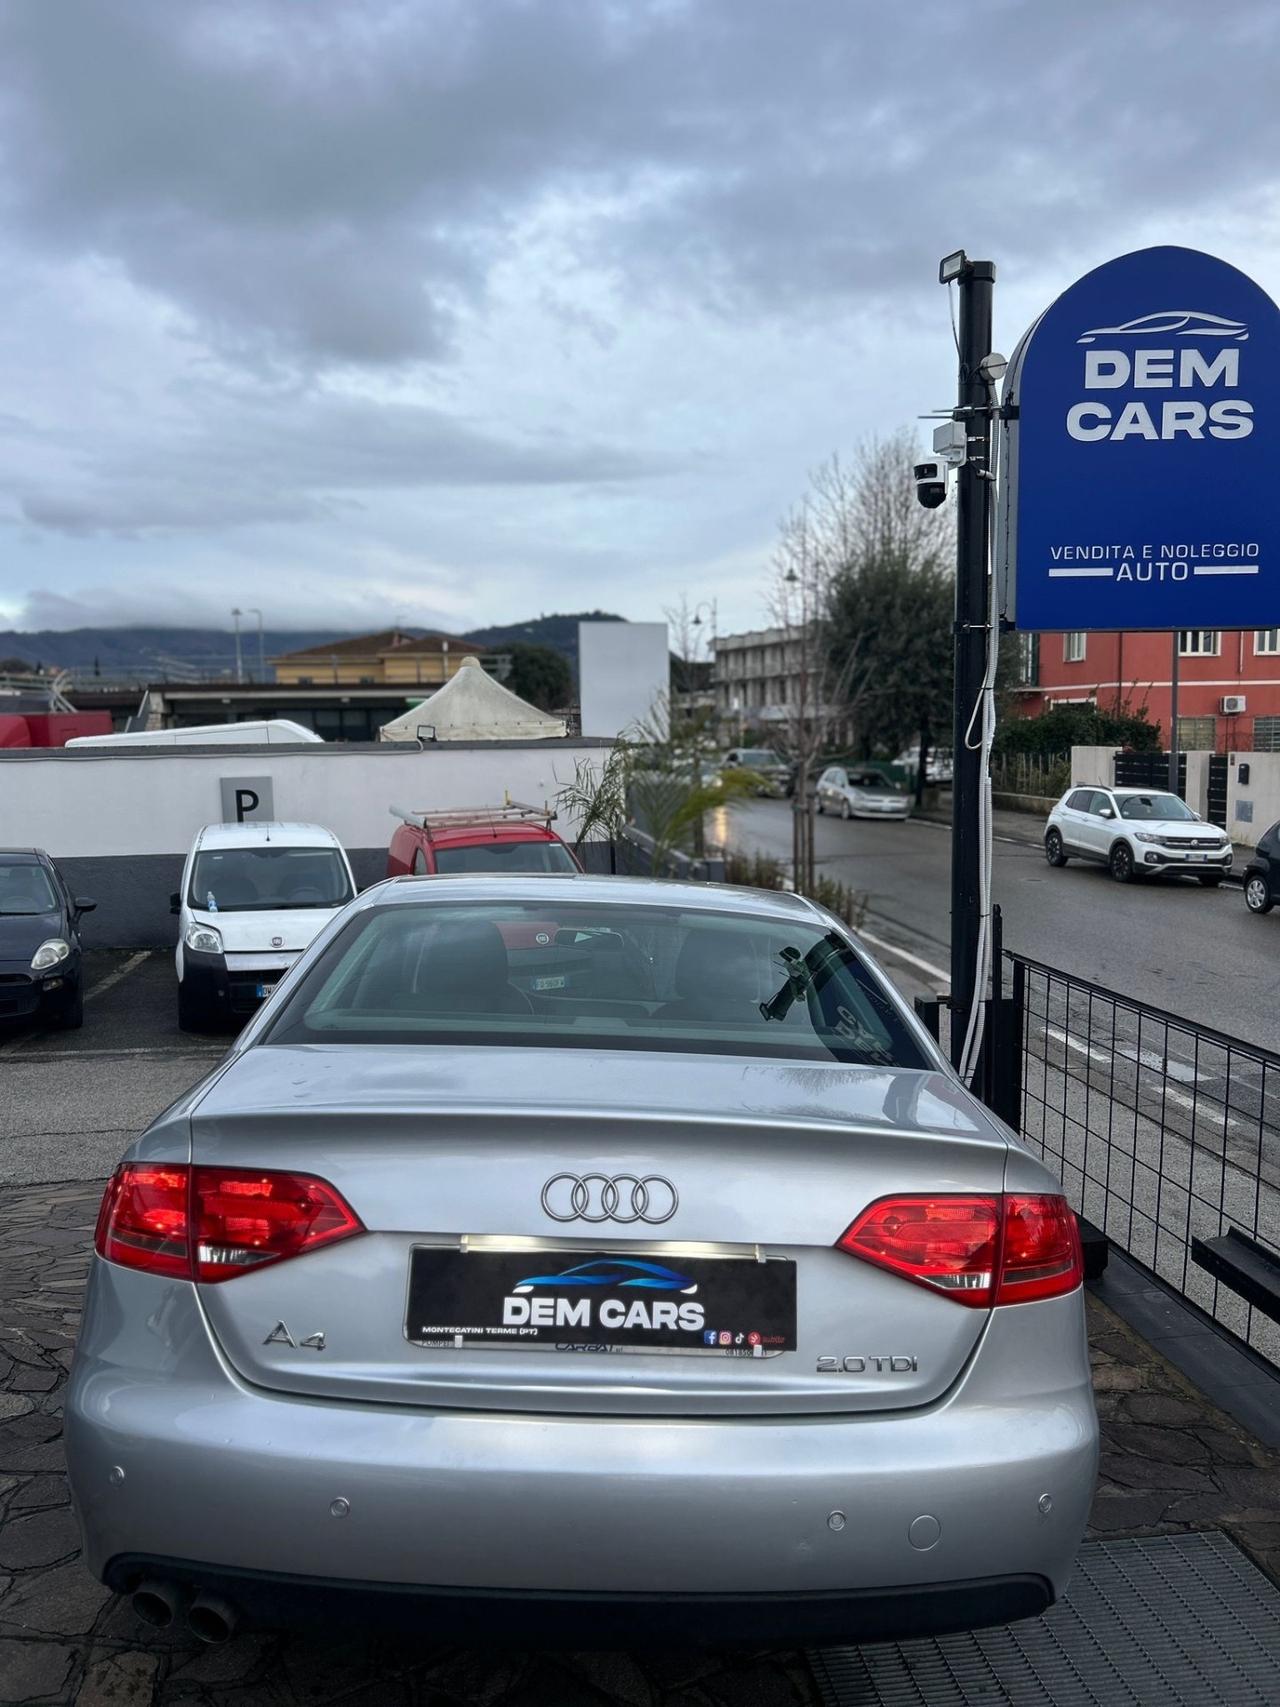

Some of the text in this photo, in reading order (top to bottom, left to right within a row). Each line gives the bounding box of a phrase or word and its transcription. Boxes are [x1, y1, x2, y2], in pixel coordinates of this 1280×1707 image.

[1084, 348, 1240, 389] DEM
[1066, 400, 1254, 442] CARS
[1050, 543, 1260, 560] VENDITA E NOLEGGIO
[1116, 562, 1189, 581] AUTO
[235, 789, 259, 823] P
[502, 1296, 705, 1331] DEM CARS
[262, 1319, 327, 1351] A4
[422, 1326, 538, 1336] MONTECATINI TERME (PT)
[816, 1356, 918, 1373] 2.0 TDI
